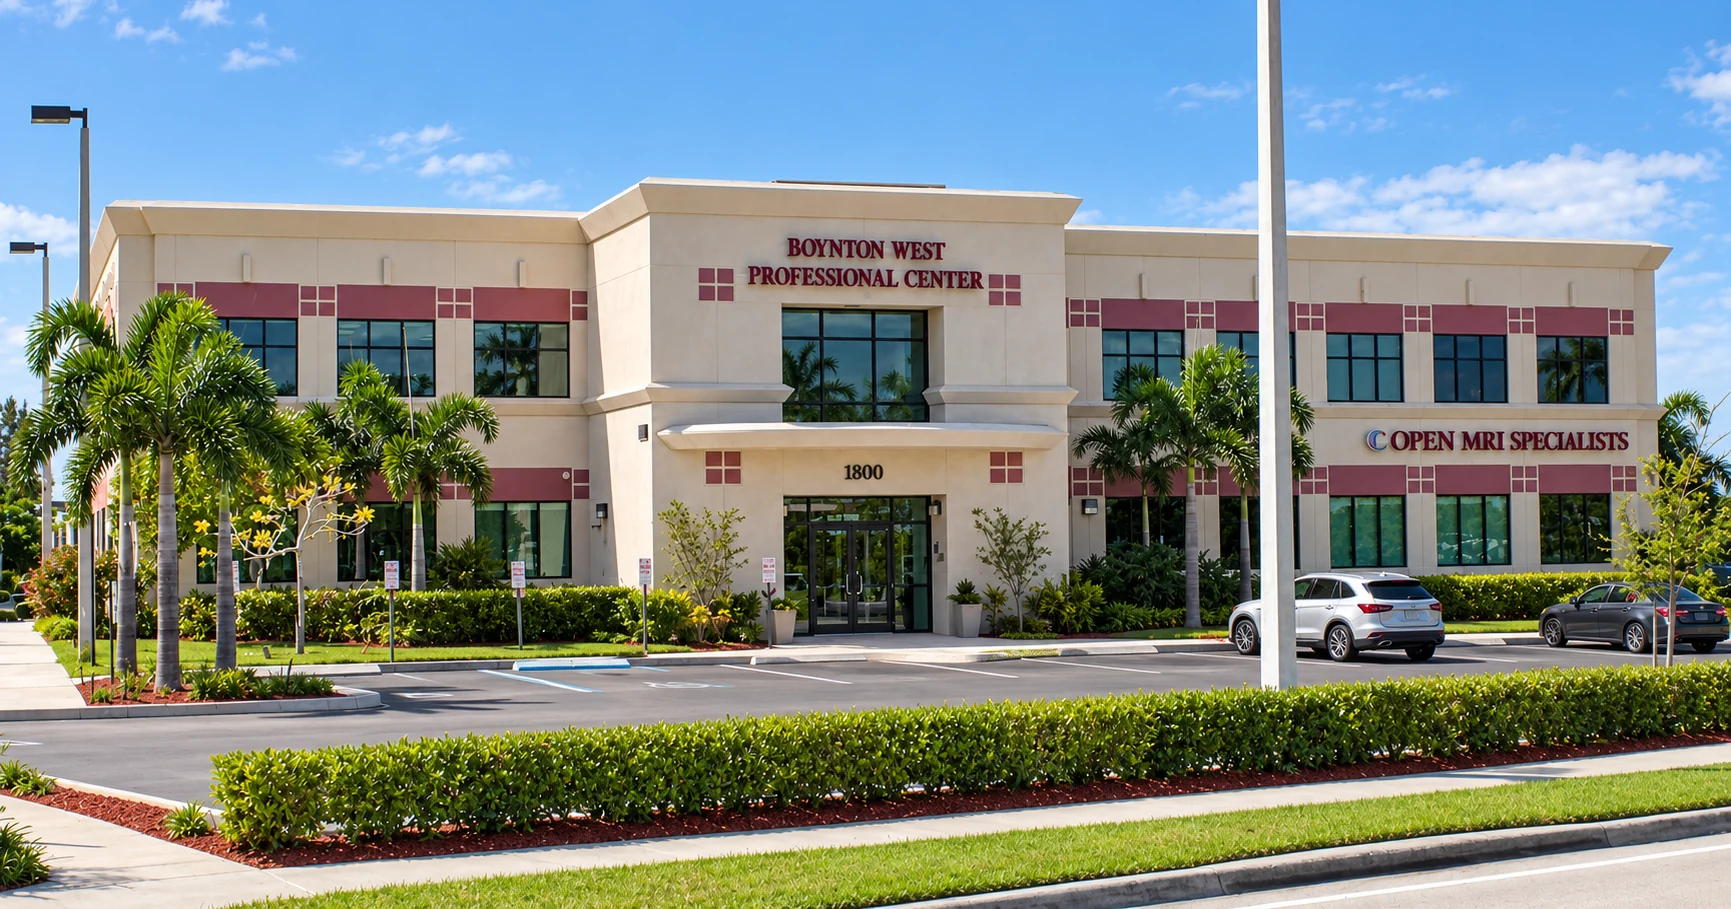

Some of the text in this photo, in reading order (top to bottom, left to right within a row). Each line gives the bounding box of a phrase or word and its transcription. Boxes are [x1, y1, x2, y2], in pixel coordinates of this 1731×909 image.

[787, 238, 946, 260] BOYNTON WEST
[748, 266, 984, 289] PROFESSIONAL CENTER
[1391, 430, 1455, 451] OPEN
[1461, 431, 1505, 451] MRI
[1510, 431, 1629, 451] SPECIALISTS
[844, 464, 884, 480] 1800
